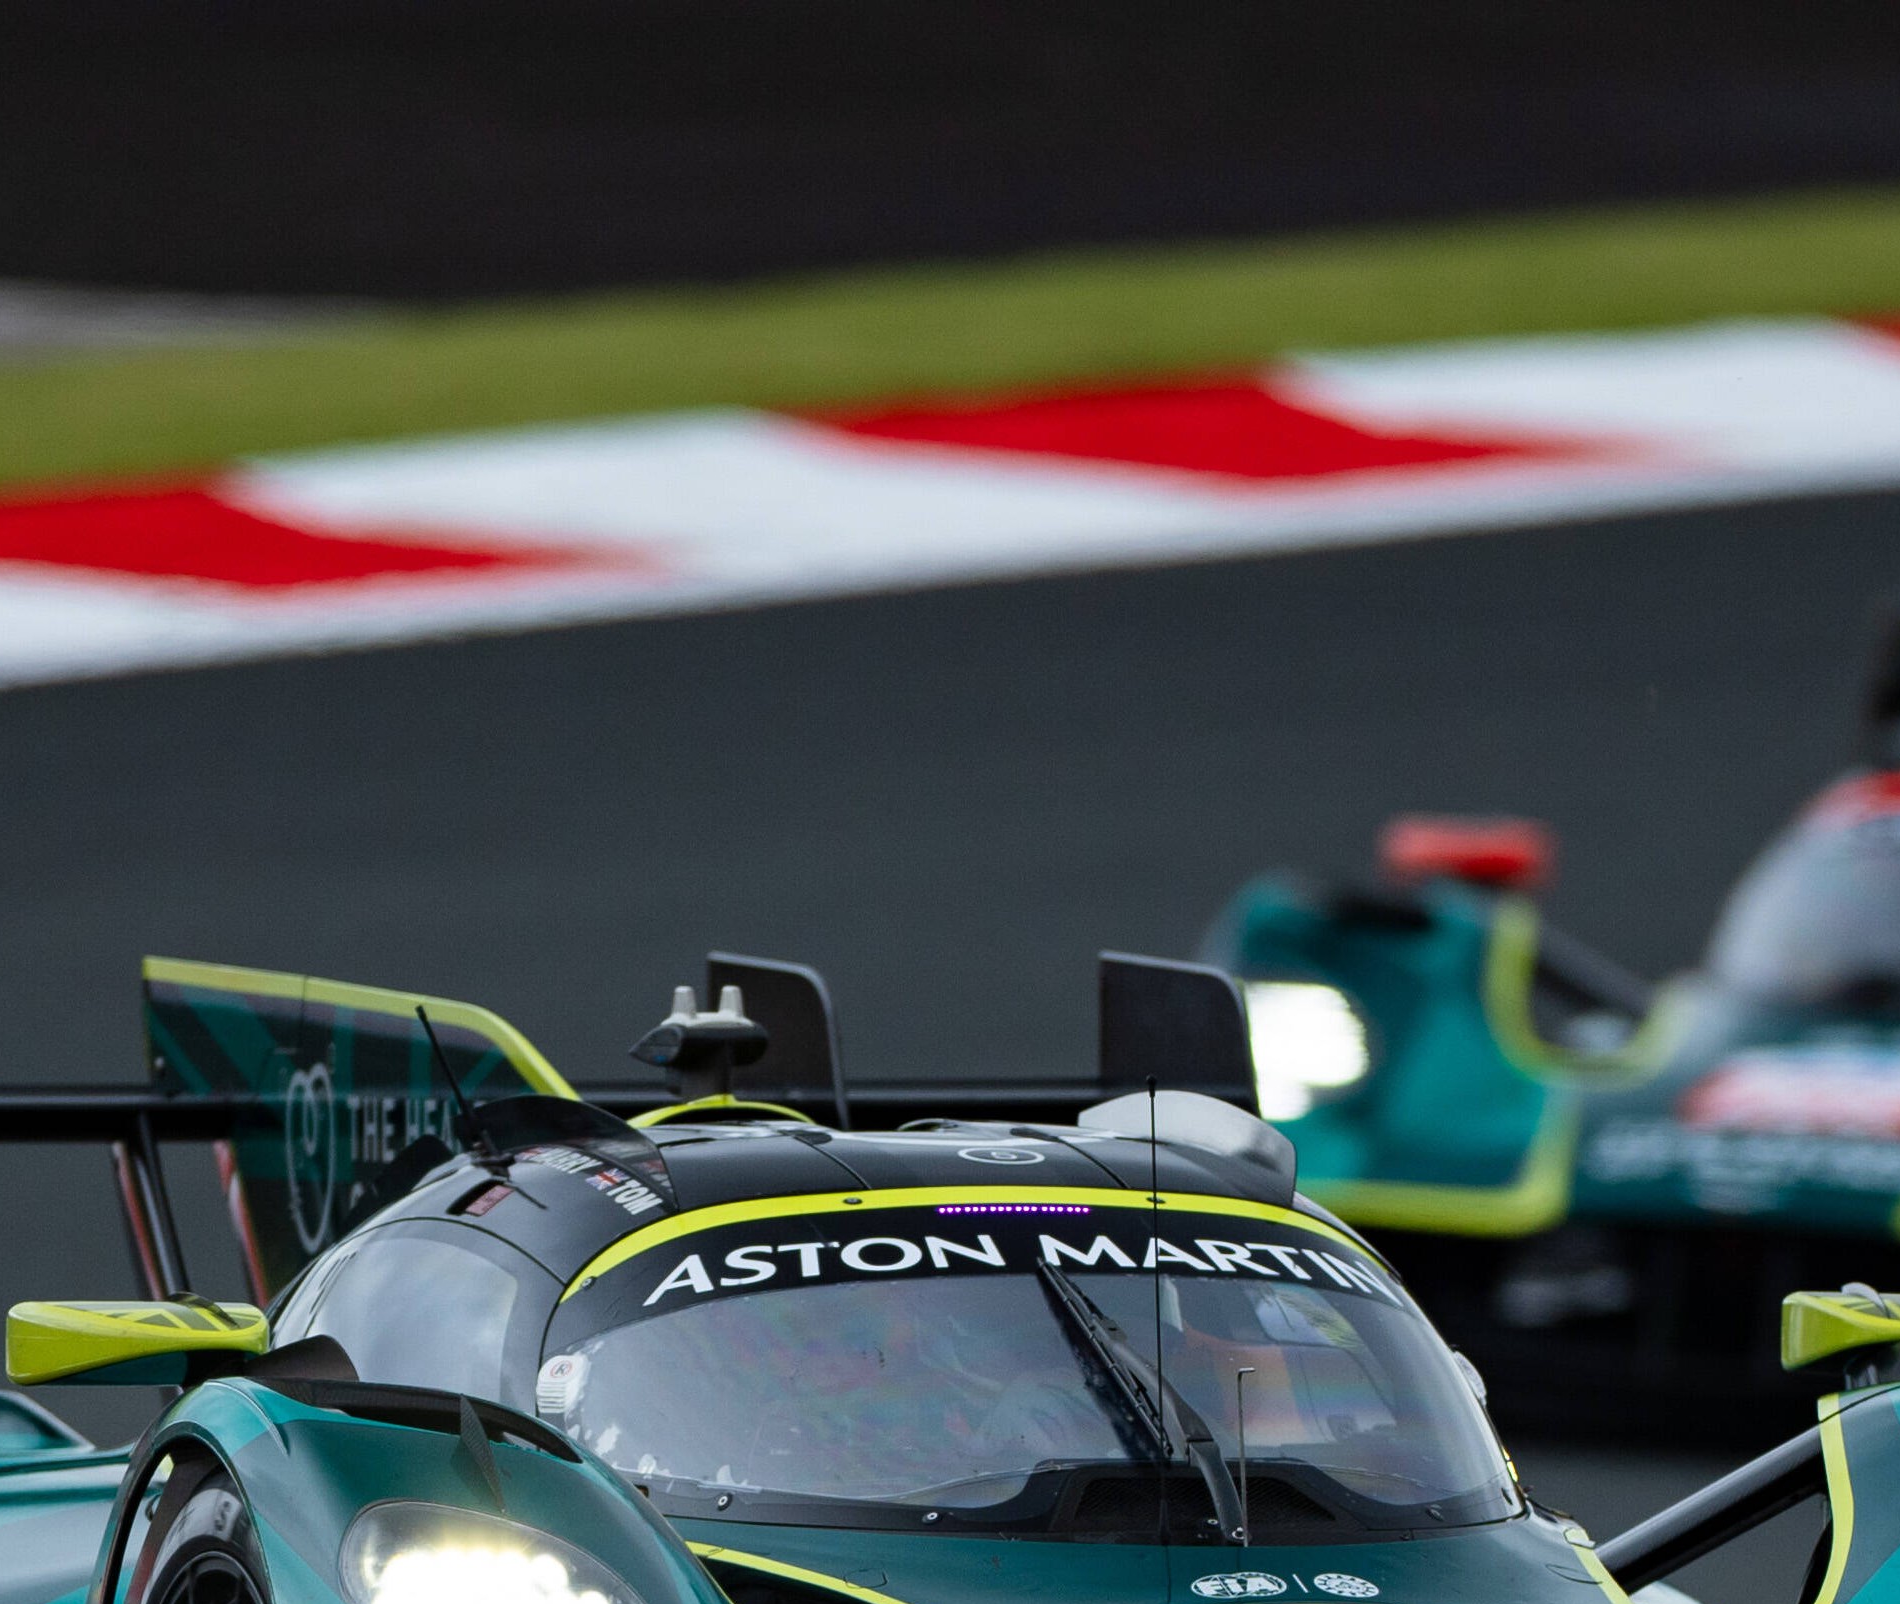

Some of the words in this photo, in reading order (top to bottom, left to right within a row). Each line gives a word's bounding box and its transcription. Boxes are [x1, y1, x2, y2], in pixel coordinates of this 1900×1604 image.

[348, 1096, 396, 1163] THE
[606, 1178, 663, 1216] TOM
[643, 1235, 1006, 1306] ASTON
[1037, 1233, 1403, 1307] MARTIN
[1196, 1577, 1281, 1597] FIA
